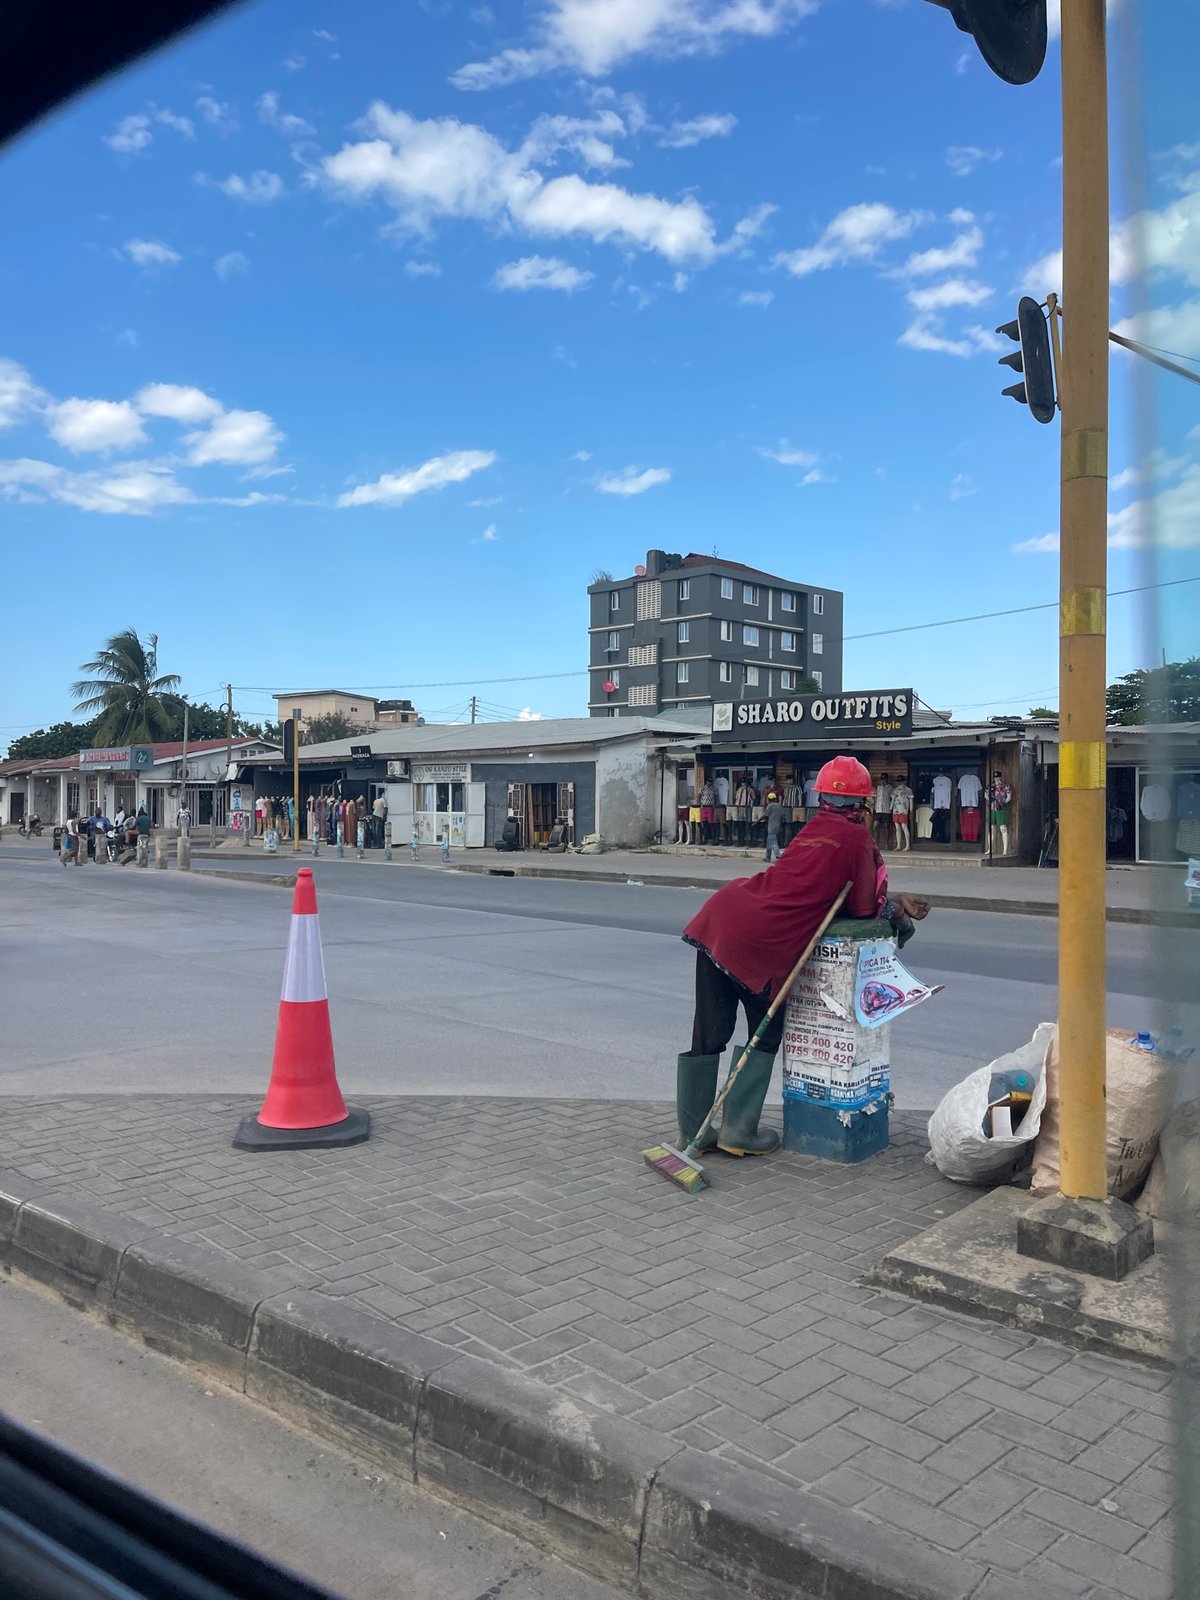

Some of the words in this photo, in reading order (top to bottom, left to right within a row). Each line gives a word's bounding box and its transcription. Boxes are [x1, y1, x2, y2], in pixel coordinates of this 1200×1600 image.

[737, 701, 803, 725] SHARO
[810, 694, 908, 721] OUTFITS
[875, 721, 901, 732] Style
[864, 957, 878, 968] PIGA
[880, 956, 890, 966] 114
[817, 967, 829, 985] 5
[817, 1024, 845, 1033] COMPUTER
[785, 1032, 809, 1045] 0655
[811, 1037, 831, 1048] 400
[833, 1041, 854, 1053] 420
[785, 1044, 809, 1057] 0755
[811, 1049, 830, 1061] 400
